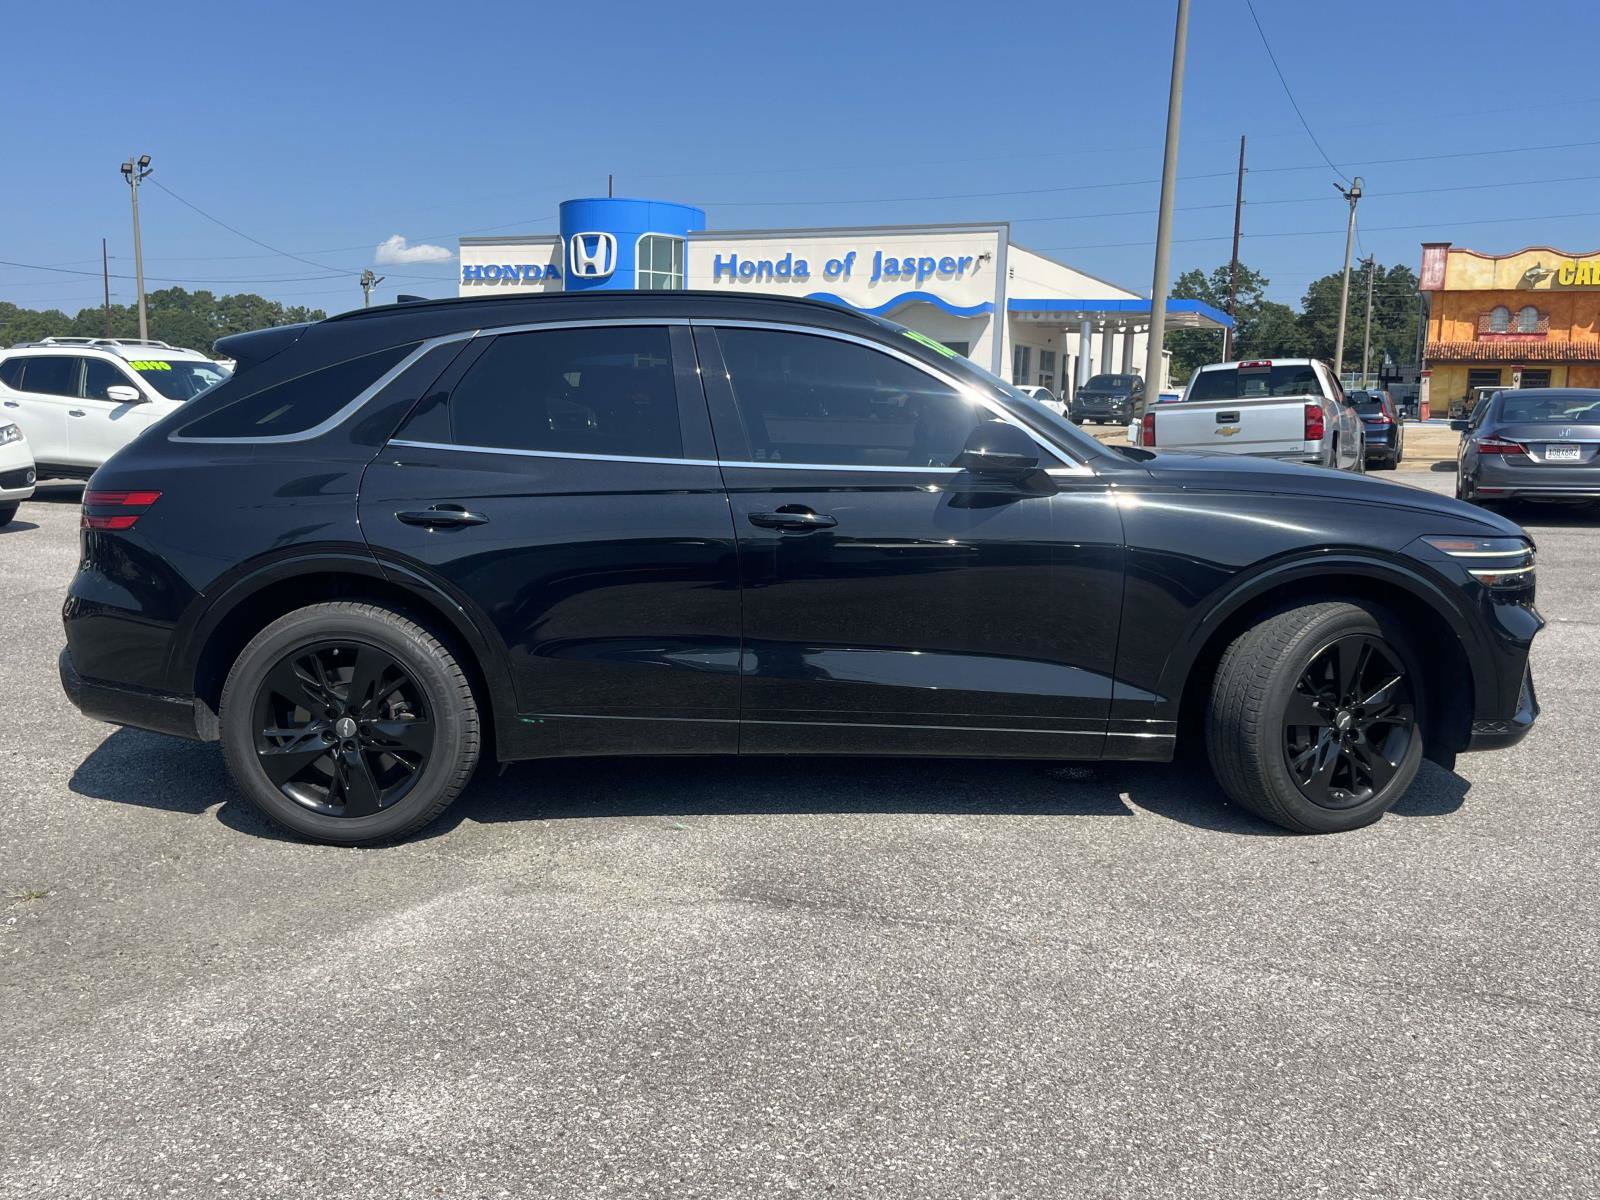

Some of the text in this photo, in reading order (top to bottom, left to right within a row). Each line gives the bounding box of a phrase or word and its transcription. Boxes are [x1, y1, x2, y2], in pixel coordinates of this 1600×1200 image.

[462, 264, 562, 280] HONDA
[714, 250, 973, 282] Honda of Jasper
